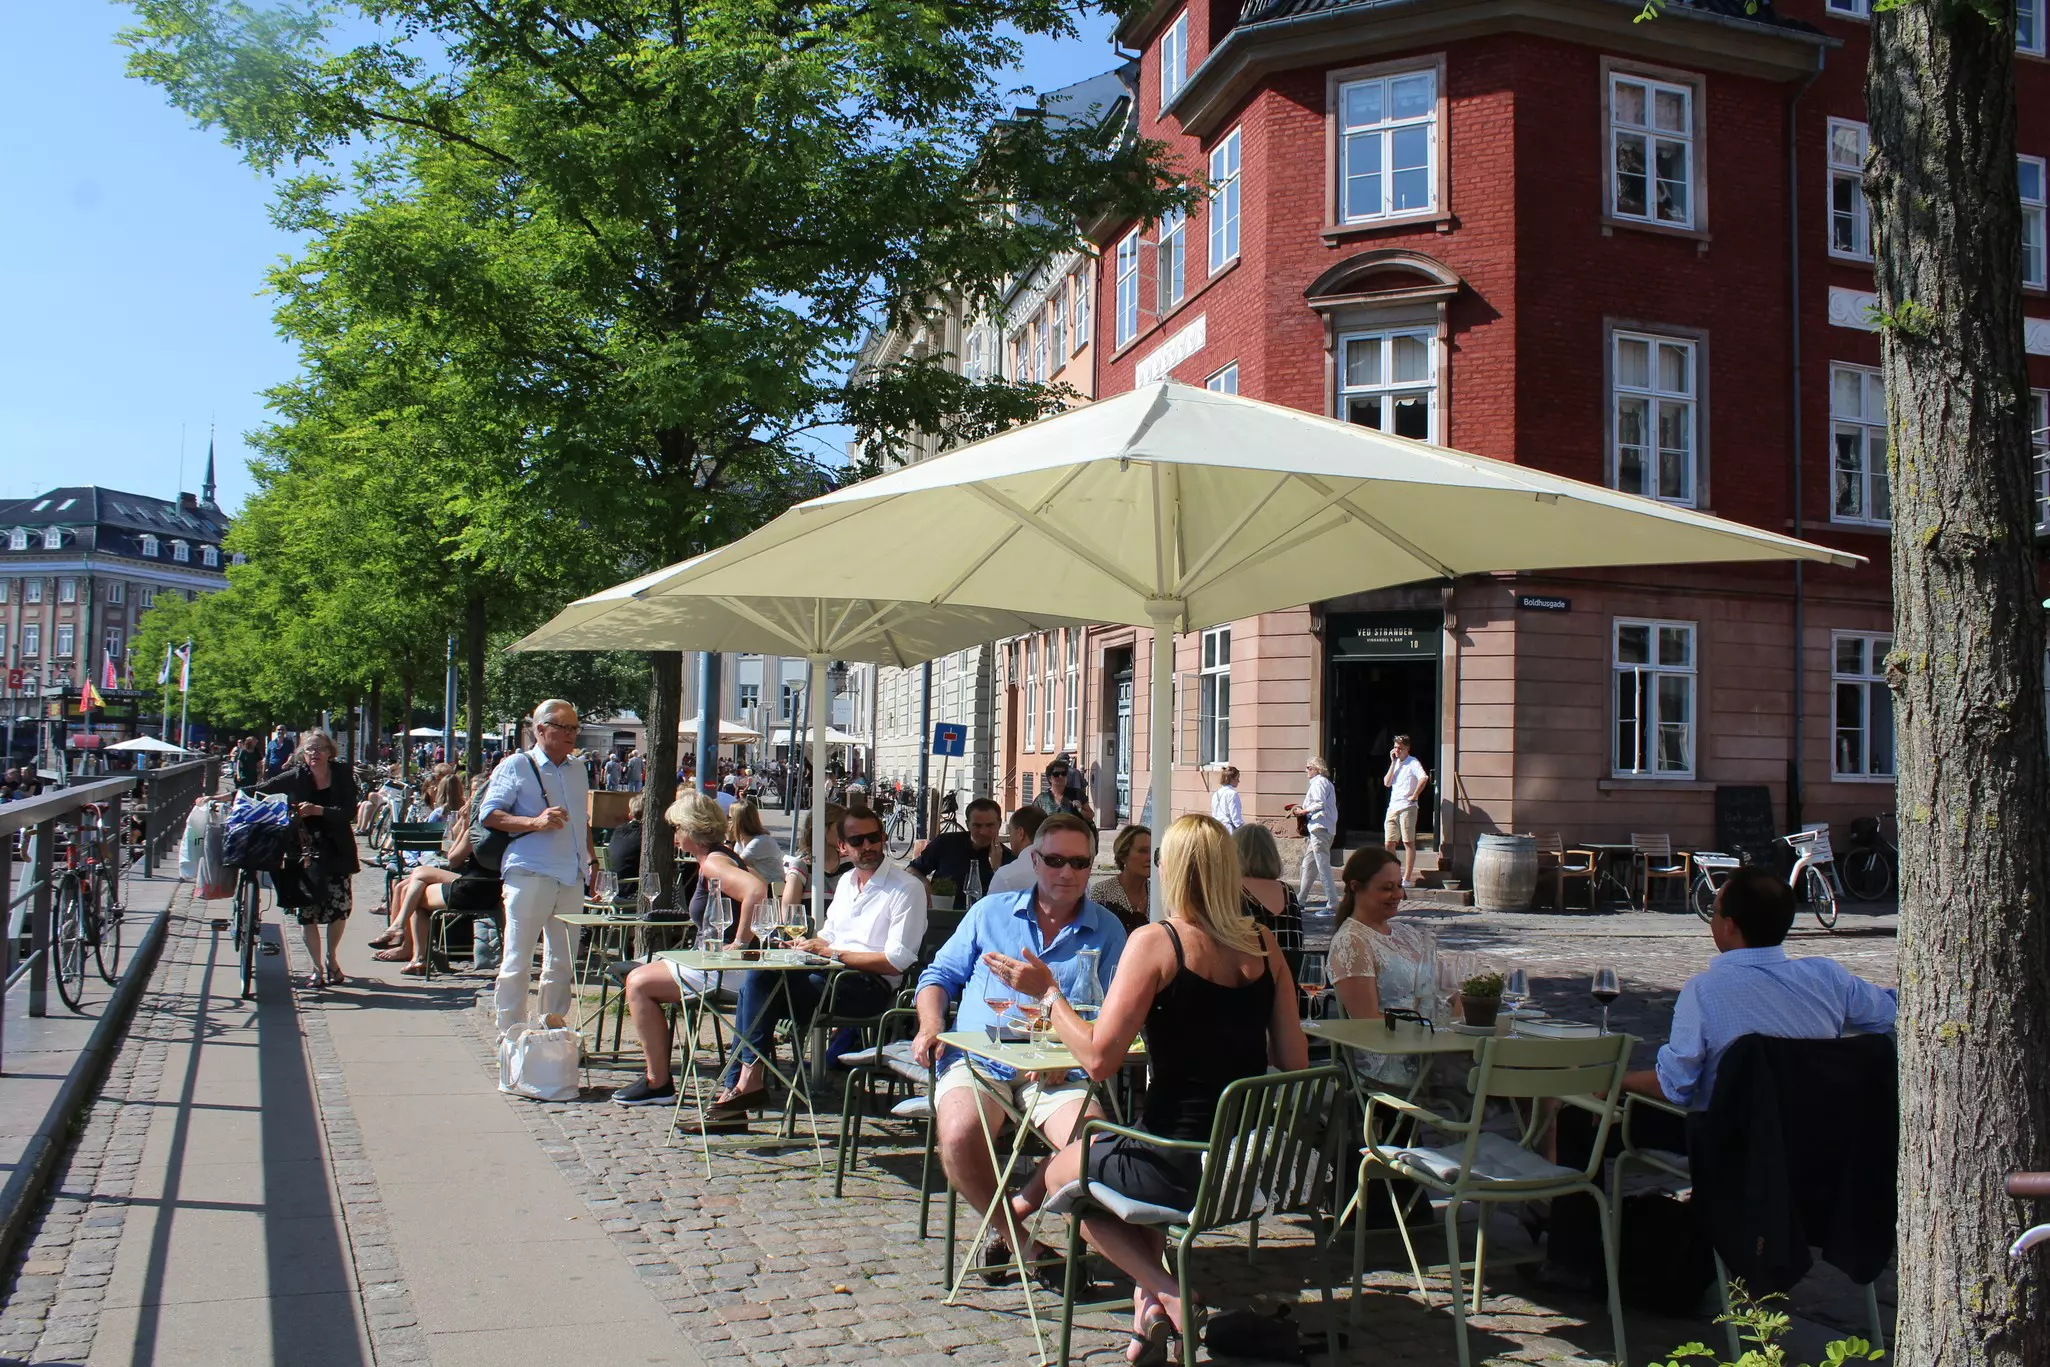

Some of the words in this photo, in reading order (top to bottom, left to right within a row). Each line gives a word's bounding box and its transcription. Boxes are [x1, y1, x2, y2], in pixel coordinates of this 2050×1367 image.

[1523, 598, 1566, 609] Boldhusgade
[1357, 628, 1371, 636] VED
[1374, 628, 1413, 636] STRANDEN
[1410, 640, 1418, 648] 10
[11, 673, 20, 684] 2
